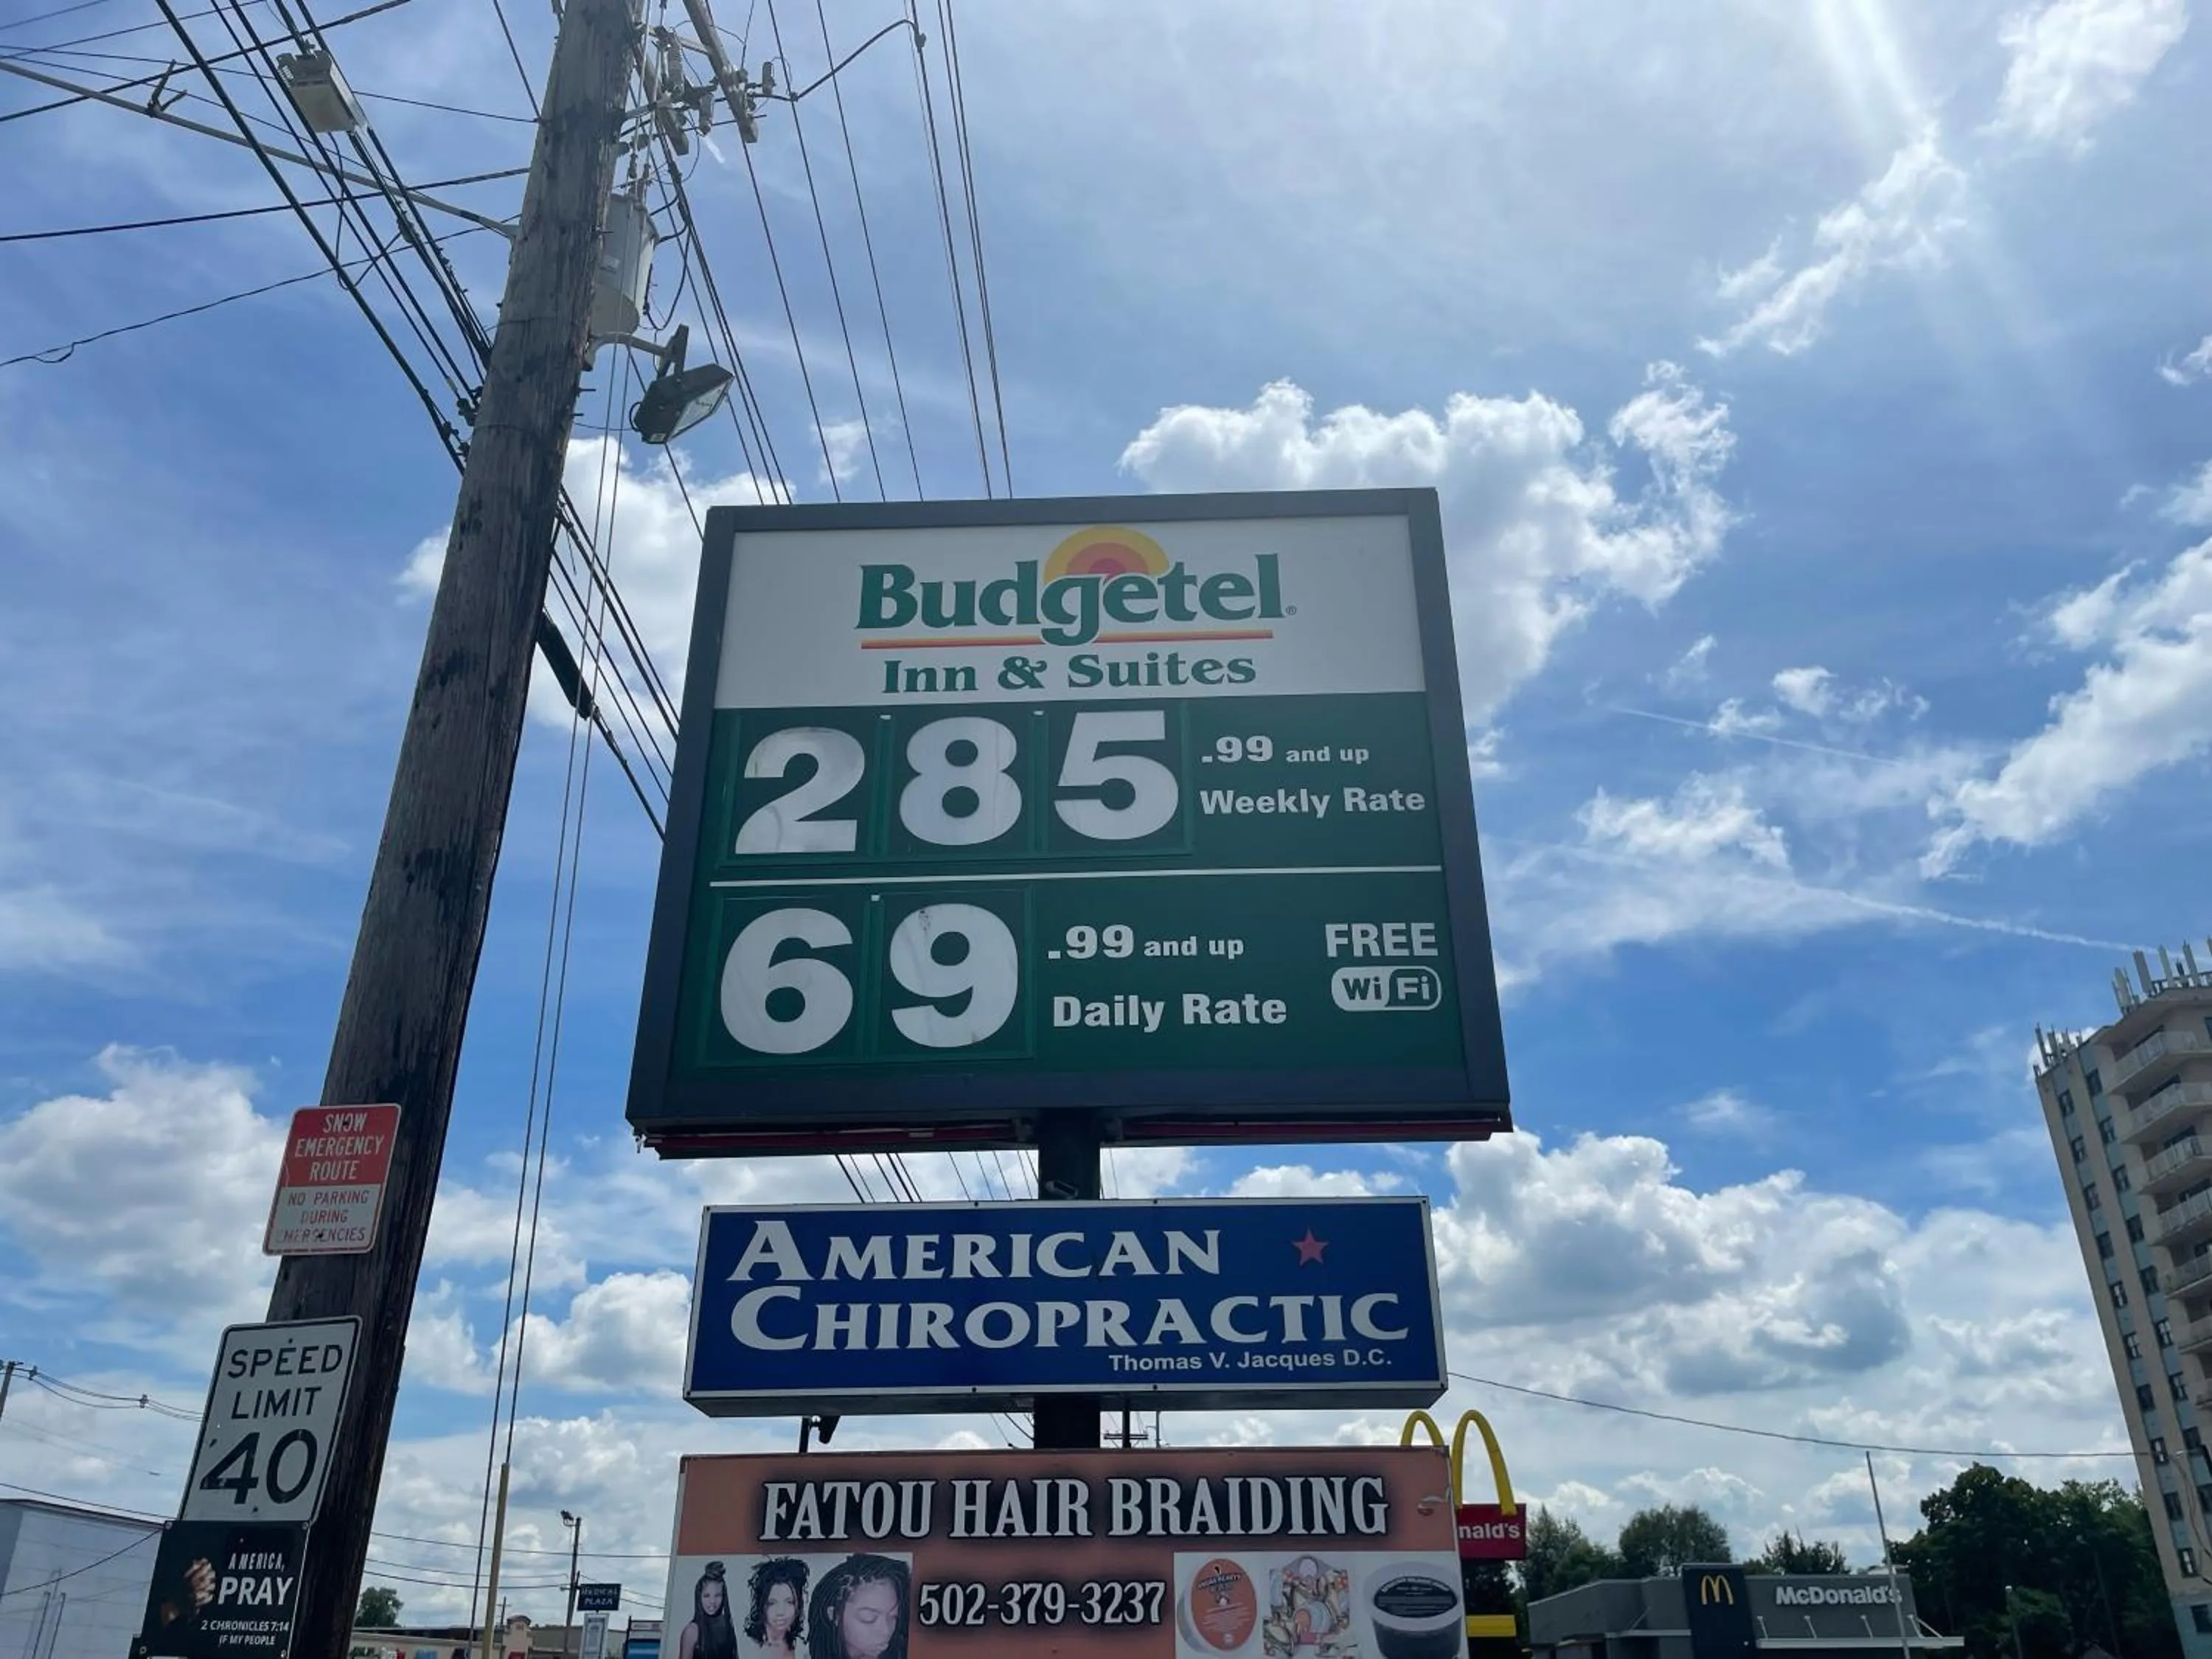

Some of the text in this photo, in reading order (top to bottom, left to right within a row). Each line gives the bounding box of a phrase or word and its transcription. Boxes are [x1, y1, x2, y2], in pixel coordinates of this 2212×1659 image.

[854, 553, 1285, 647] Budgetel
[882, 652, 1256, 694] Inn & Suites
[1201, 735, 1273, 763] .99
[1285, 746, 1331, 762] and
[1340, 748, 1369, 765] up
[1200, 787, 1425, 818] Weekly Rate
[1325, 922, 1439, 958] FREE
[720, 902, 1245, 1054] 69 .99 and up
[1054, 993, 1287, 1033] Daily Rate
[323, 1113, 366, 1133] SNOW
[295, 1135, 384, 1158] EMERGENCY
[310, 1160, 359, 1180] ROUTE
[288, 1190, 370, 1206] NO PARKING
[301, 1210, 349, 1224] DURING
[726, 1220, 1221, 1281] AMERICAN
[730, 1285, 1408, 1351] CHIROPRACTIC
[228, 1344, 343, 1378] SPEED
[1108, 1349, 1392, 1371] Thomas V. Jacques D.C.
[232, 1386, 321, 1419] LIMIT
[199, 1428, 318, 1504] 40
[759, 1476, 1389, 1541] FATOU HAIR BRAIDING
[1458, 1523, 1520, 1540] nald's
[218, 1576, 294, 1605] PRAY
[919, 1581, 1166, 1626] 502-379-3237
[1775, 1585, 1902, 1605] McDonald's
[201, 1621, 289, 1632] 2 CHRONICLES 7:14
[244, 1635, 276, 1645] PEOPLE
